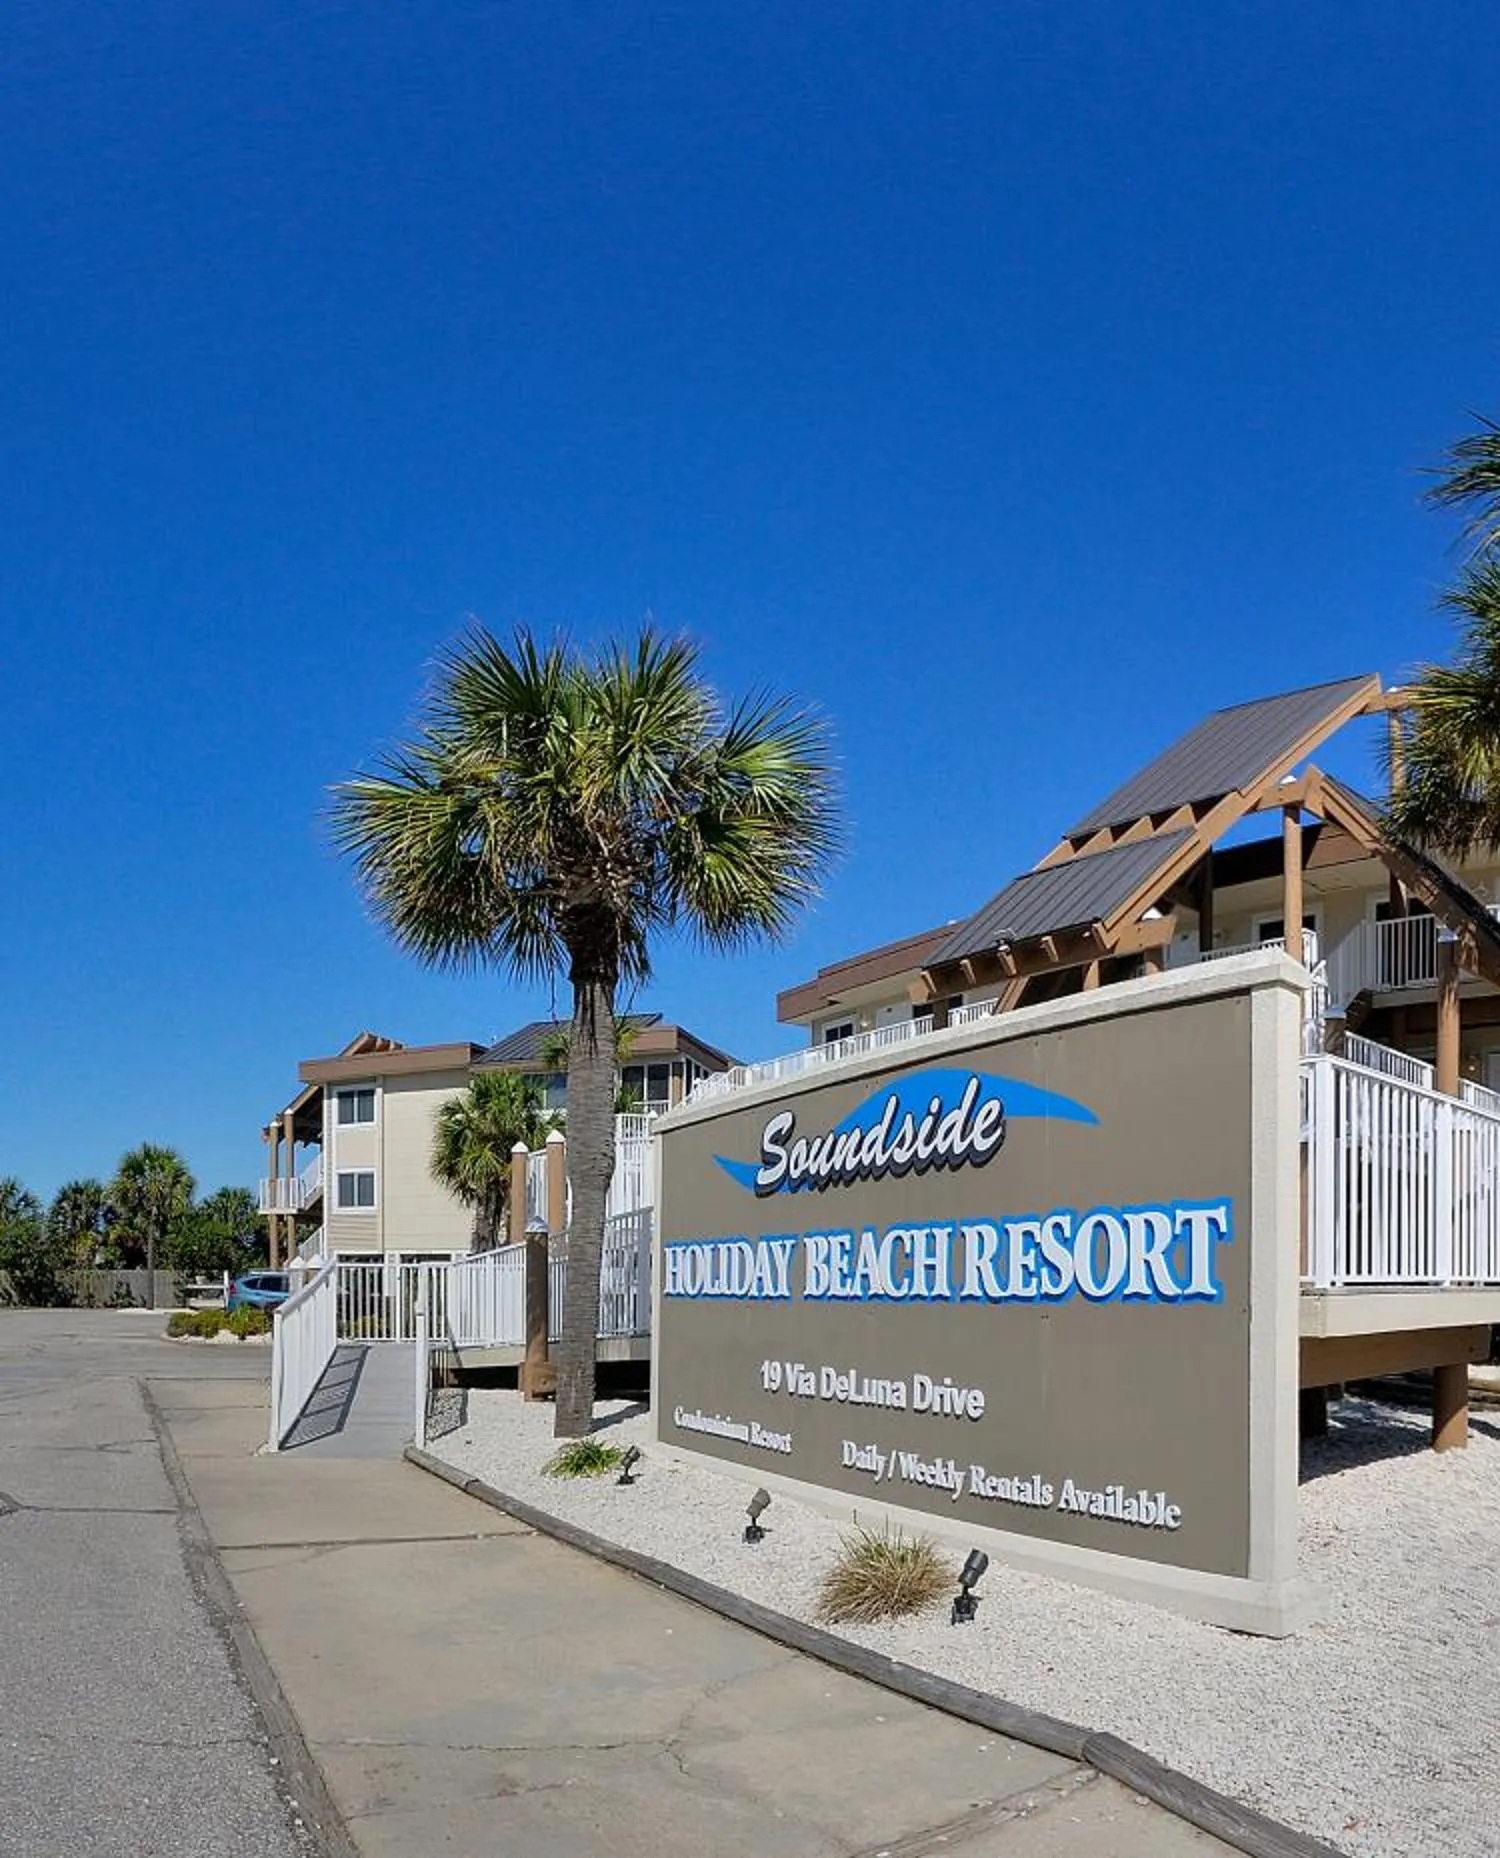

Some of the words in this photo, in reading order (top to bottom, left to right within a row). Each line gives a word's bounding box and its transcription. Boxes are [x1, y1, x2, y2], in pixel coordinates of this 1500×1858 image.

[755, 1074, 1004, 1196] Soundside
[663, 1238, 797, 1299] HOLIDAY
[803, 1226, 951, 1299] BEACH
[961, 1205, 1229, 1301] RESORT
[761, 1360, 782, 1393] 19
[785, 1361, 816, 1398] Via
[819, 1366, 907, 1410] DeLuna
[913, 1374, 985, 1421] Drive
[750, 1421, 792, 1455] Resort
[969, 1464, 1053, 1508] Rentals
[1057, 1479, 1183, 1532] Available
